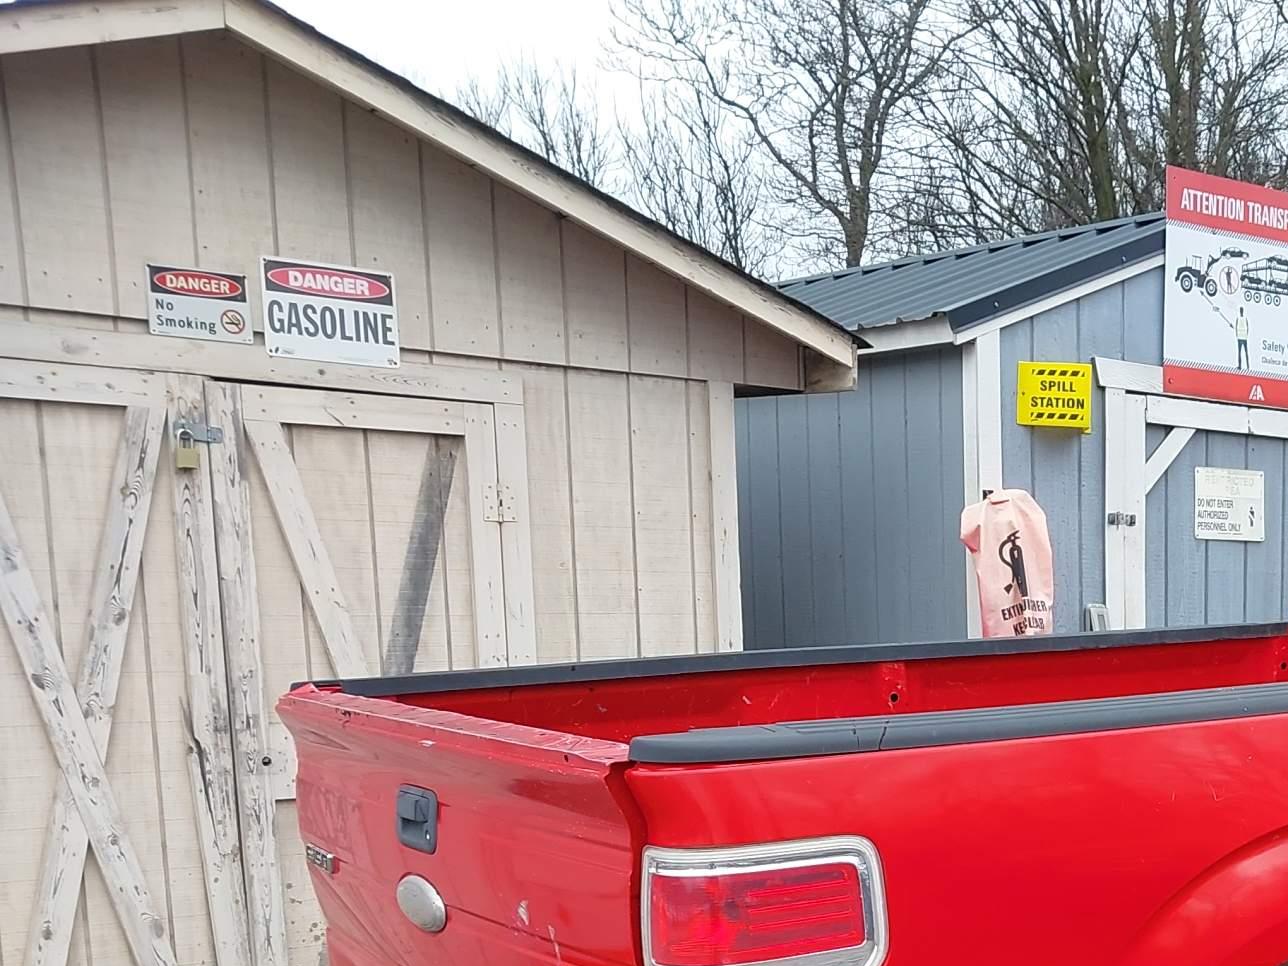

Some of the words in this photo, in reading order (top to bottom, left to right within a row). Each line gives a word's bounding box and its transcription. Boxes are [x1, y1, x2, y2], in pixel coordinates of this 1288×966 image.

[1180, 187, 1245, 222] ATTENTION
[165, 274, 230, 295] DANGER
[287, 270, 370, 296] DANGER
[155, 298, 174, 311] No
[156, 315, 217, 335] Smoking
[267, 299, 395, 347] GASOLINE
[1262, 339, 1285, 356] Safety
[1040, 380, 1076, 393] SPILL
[1030, 396, 1085, 410] STATION
[1197, 497, 1205, 508] DO
[1206, 498, 1216, 509] NOT
[1217, 499, 1234, 509] ENTER
[1227, 522, 1241, 532] ONLY
